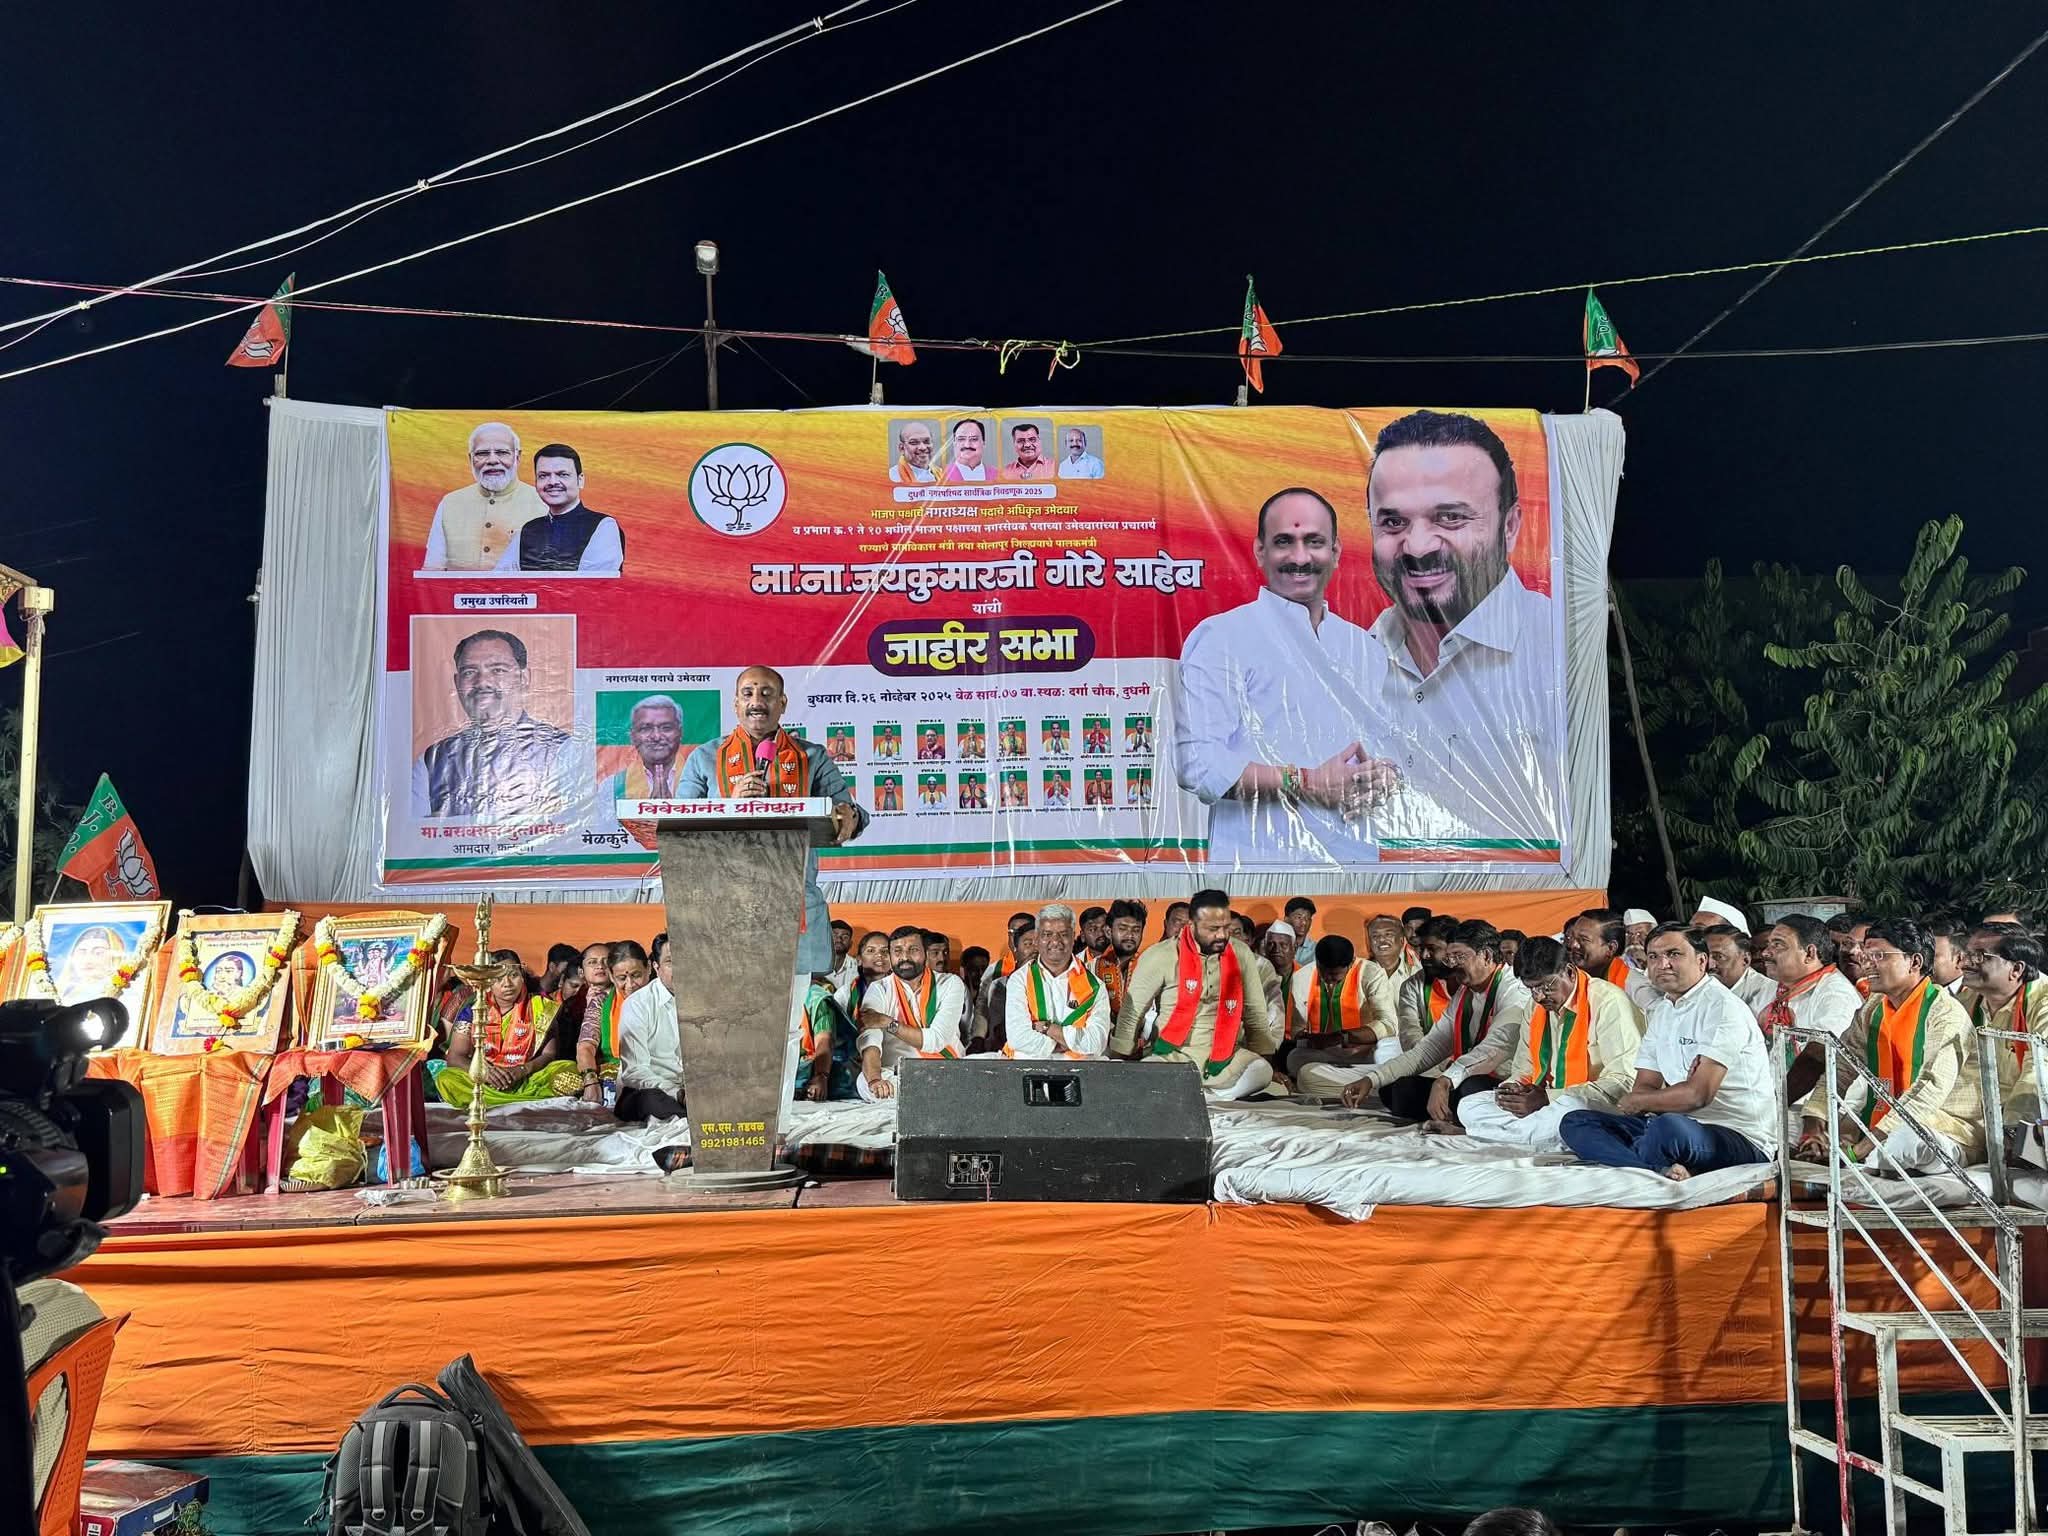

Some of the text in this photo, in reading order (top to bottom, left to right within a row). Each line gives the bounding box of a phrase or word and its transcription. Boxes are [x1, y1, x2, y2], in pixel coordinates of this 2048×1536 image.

[1024, 487, 1043, 496] 2025
[871, 503, 1079, 519] भाजप पक्षाचे नगराध्यक्ष पदाचे अधिकृत उमेदवार
[803, 525, 831, 536] प्रभाग
[857, 523, 865, 535] ते
[868, 526, 881, 535] १०
[885, 522, 912, 535] मधील
[914, 524, 943, 535] भाजप
[945, 523, 981, 534] पक्षाच्या
[984, 519, 1027, 533] नगरसेवक
[1030, 521, 1062, 532] पदाच्या
[1065, 519, 1118, 531] उमेदवारांच्या
[1121, 517, 1156, 531] प्रचारार्थ
[859, 542, 889, 552] राज्याचे
[938, 539, 955, 551] मंत्री
[976, 539, 1008, 552] सोलापूर
[750, 549, 1205, 603] मा.ना.जयकुमारजी गोरे साहेब
[460, 594, 529, 608] प्रमुख उपस्थिती
[972, 598, 1003, 614] यांची
[883, 620, 1079, 671] जाहीर सभा
[605, 672, 711, 683] नगराध्यक्ष पदाचे उमेदवार
[807, 694, 842, 708] बुधवार
[921, 690, 952, 702] २०२५
[955, 688, 974, 702] वेळ
[1068, 682, 1088, 697] दर्गा
[1122, 682, 1151, 700] दुधनी
[637, 800, 806, 815] विवेकानंद प्रतिष्ठान
[581, 828, 630, 848] मेळकुंदे
[701, 1121, 765, 1135] एस.एस. तडवळ
[700, 1135, 765, 1149] 9921981465
